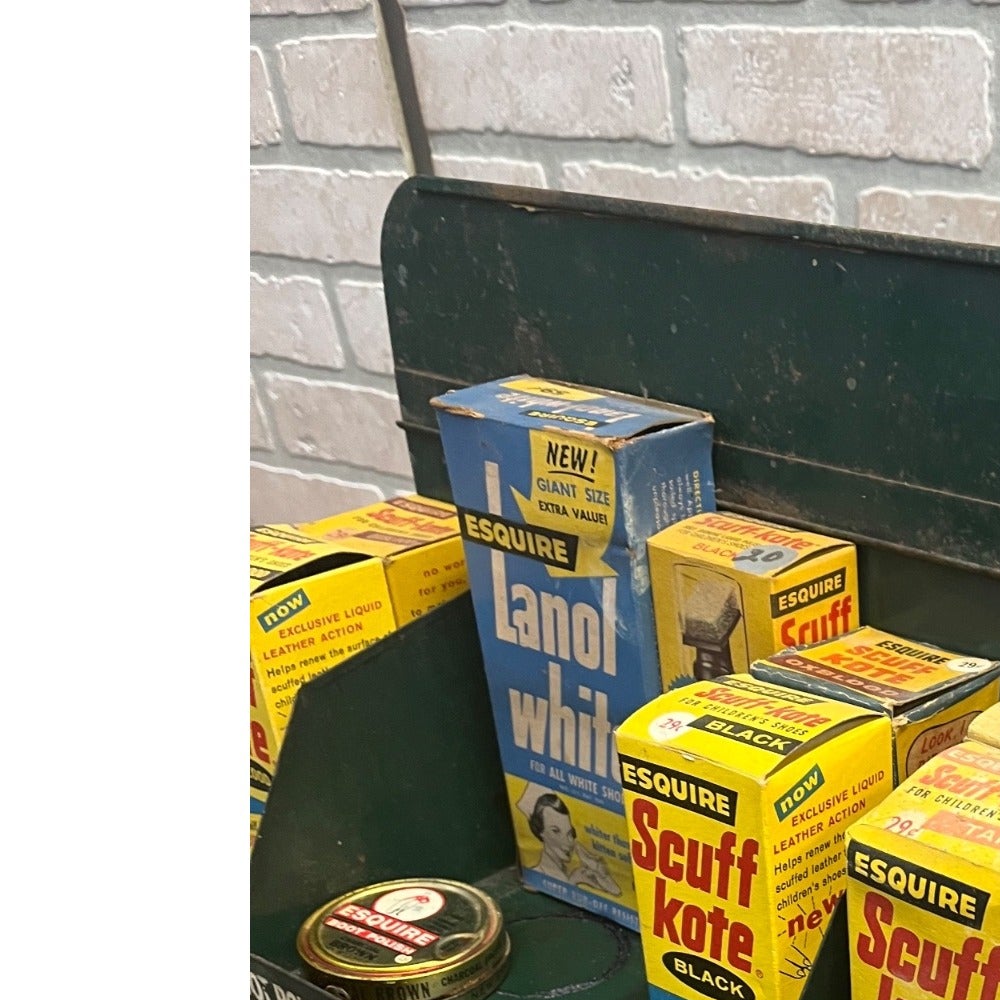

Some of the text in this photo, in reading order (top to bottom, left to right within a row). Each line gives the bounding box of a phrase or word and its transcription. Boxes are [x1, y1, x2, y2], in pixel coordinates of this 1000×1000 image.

[528, 410, 599, 428] ESQUIRE
[547, 441, 598, 474] NEW!
[536, 477, 611, 507] GIANT SIZE
[538, 500, 608, 526] EXTRA VALUE!
[465, 515, 570, 563] ESQUIRE
[423, 568, 439, 578] no
[484, 460, 617, 677] Lanol
[264, 593, 303, 626] now
[418, 585, 437, 597] for
[778, 574, 843, 611] ESQUIRE
[278, 600, 383, 639] EXCLUSIVE LIQUID
[263, 622, 363, 661] LEATHER ACTION
[876, 640, 950, 665] ESQUIRE
[267, 647, 345, 679] Helps renew the
[785, 658, 900, 698] OXBLOOD
[819, 653, 914, 685] KOTE
[844, 645, 940, 676] SCUFF
[679, 698, 809, 736] FOR CHILDREN'S SHOES
[694, 687, 832, 727] Scuff-kote
[704, 719, 791, 751] BLACK
[530, 759, 546, 775] FOR
[549, 766, 565, 782] ALL
[568, 773, 598, 794] WHITE
[622, 761, 730, 817] ESQUIRE
[778, 771, 819, 813] now
[906, 785, 930, 800] FOR
[791, 770, 885, 827] EXCLUSIVE LIQUID
[772, 798, 867, 855] LEATHER ACTION
[631, 798, 759, 909] Scuff
[774, 856, 802, 876] Helps
[805, 840, 831, 861] renew
[775, 853, 842, 893] scuffed leather
[854, 851, 976, 920] ESQUIRE
[776, 881, 820, 911] children's
[788, 889, 847, 938] new
[326, 918, 362, 938] BOOT
[366, 929, 418, 955] POLISH
[341, 905, 435, 946] ESQUIRE
[653, 876, 755, 974] kote
[376, 982, 431, 1000] BROWN
[672, 957, 746, 999] BLACK
